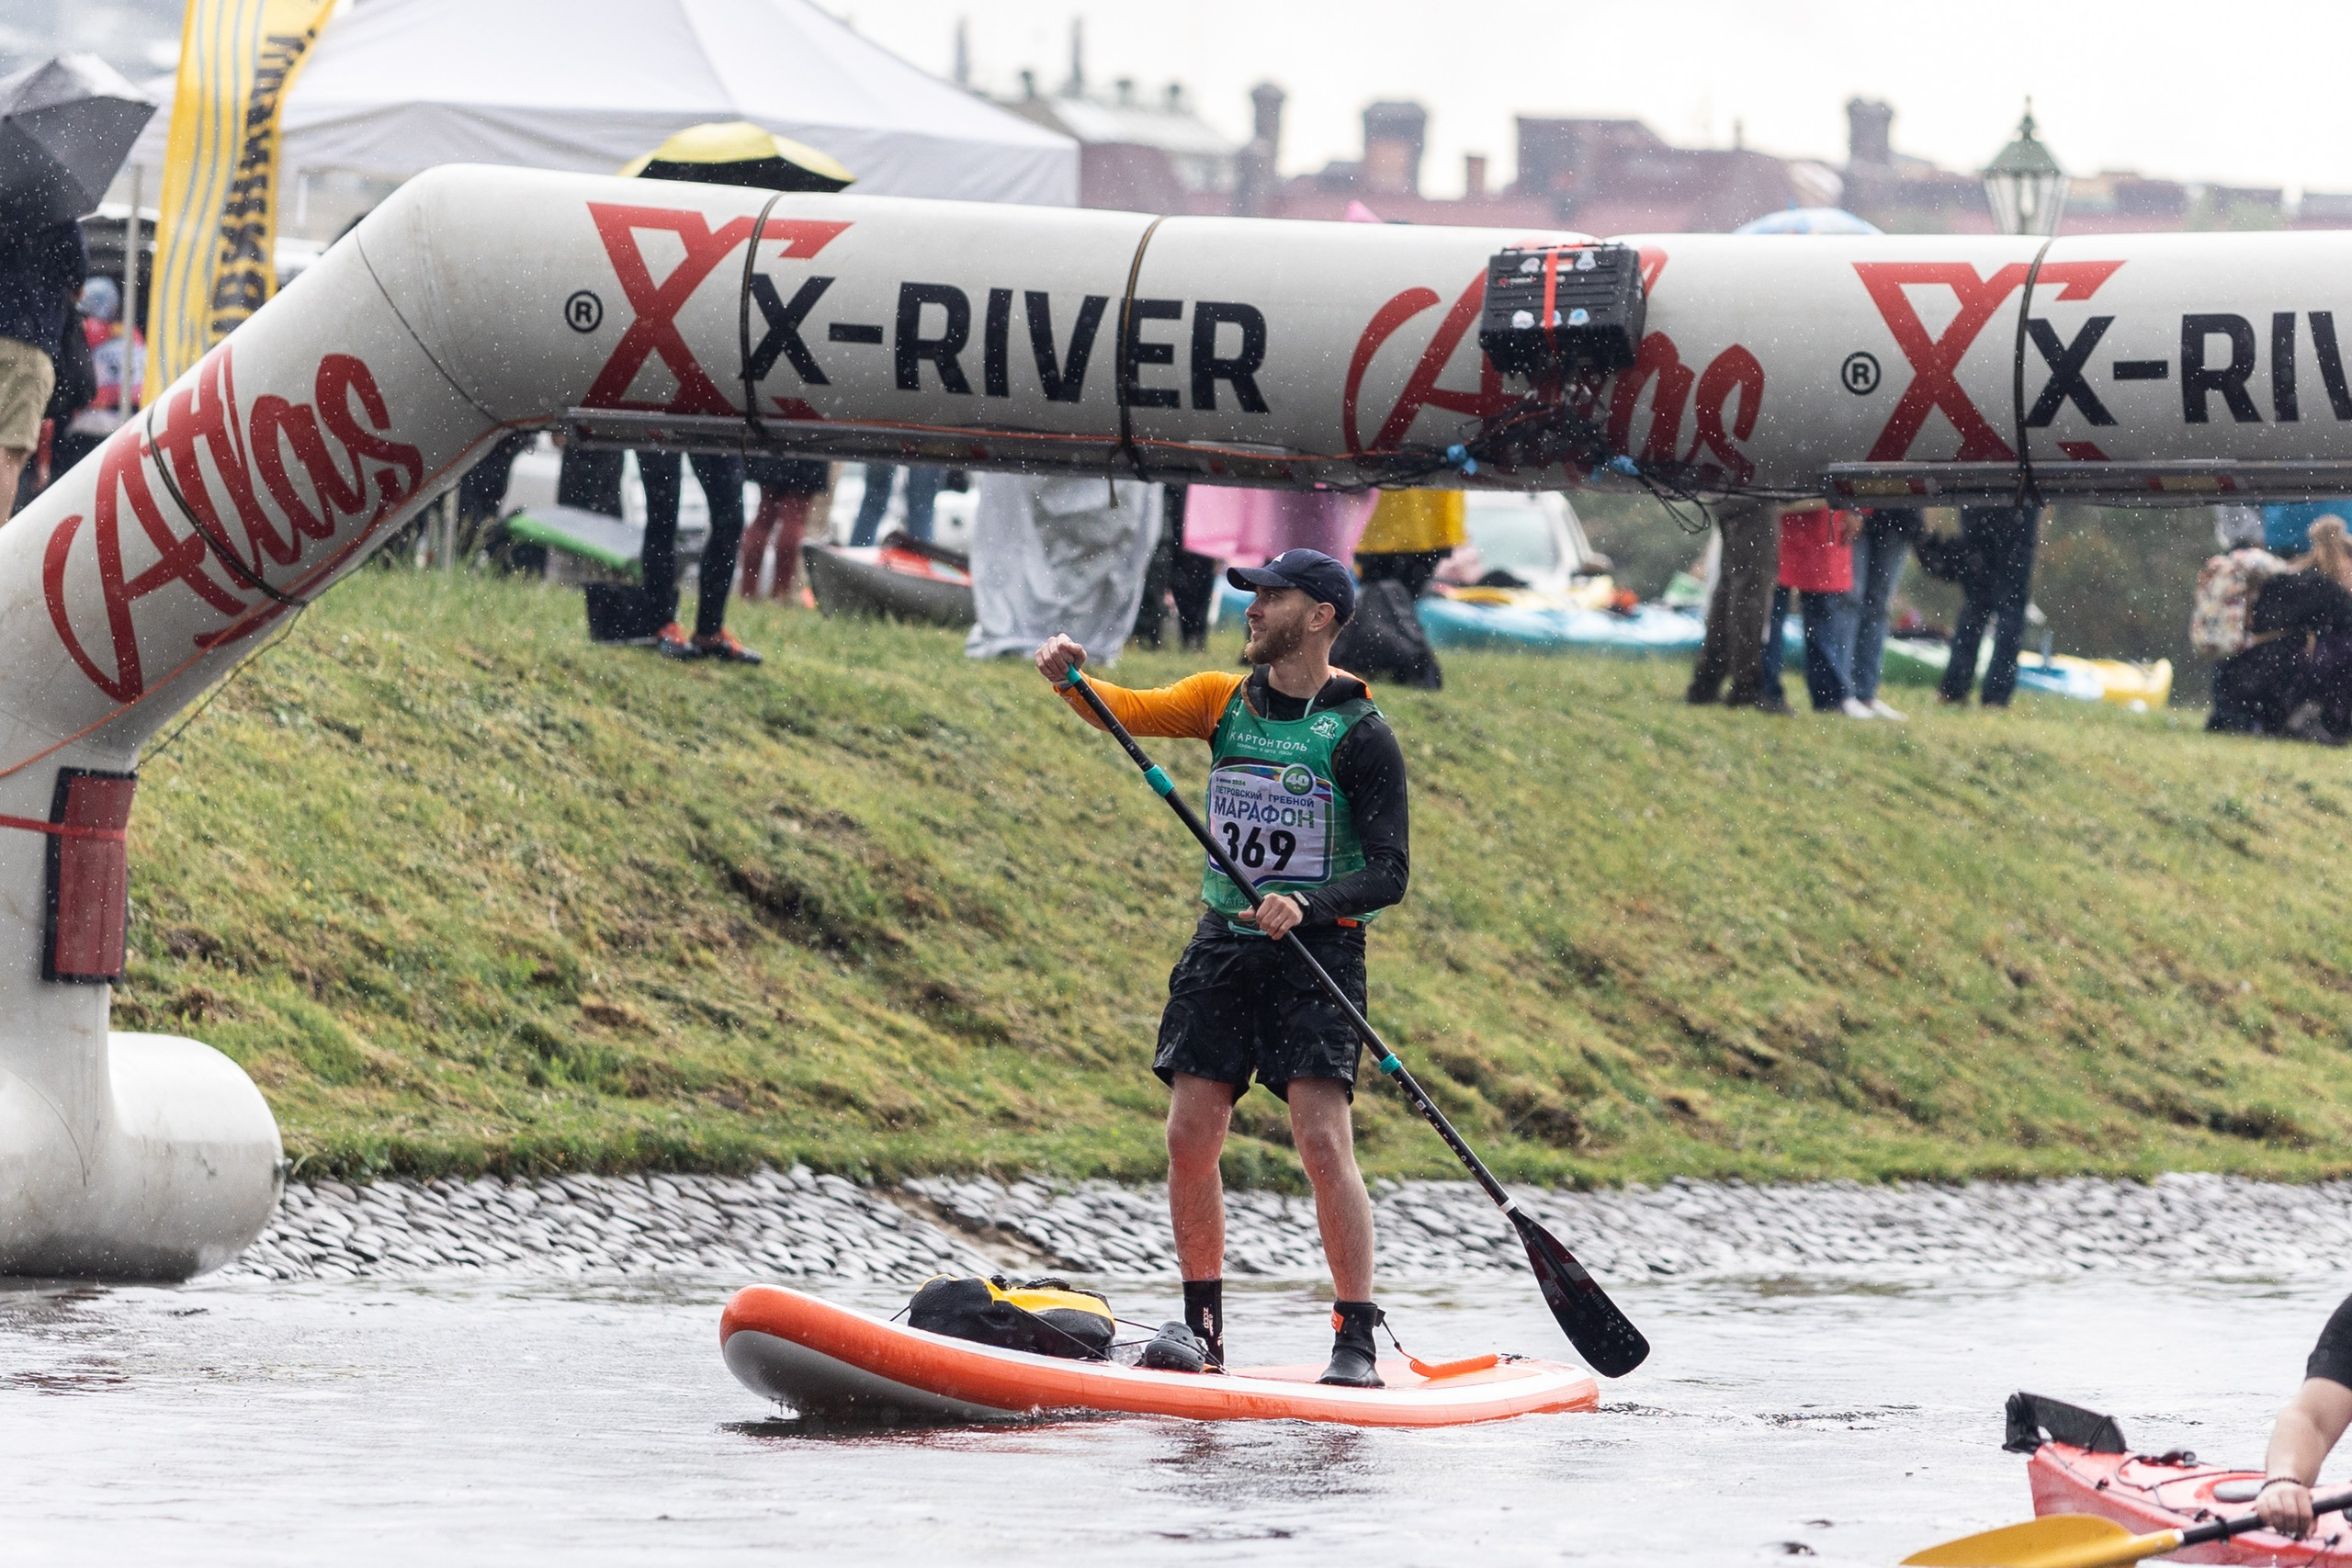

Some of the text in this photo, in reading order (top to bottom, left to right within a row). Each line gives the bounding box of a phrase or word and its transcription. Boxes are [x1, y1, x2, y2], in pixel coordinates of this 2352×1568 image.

[739, 273, 1272, 414] X-RIVER
[1342, 237, 1765, 488] Aas
[42, 343, 424, 705] Atlas
[1230, 731, 1307, 751] КАРТОНТОЛЬ
[1216, 785, 1315, 807] ПЕТРОВСКИЙ ГРЕБНОЙ
[1286, 773, 1309, 786] 40
[1214, 795, 1315, 829] МАРАФОН
[1222, 821, 1296, 871] 369
